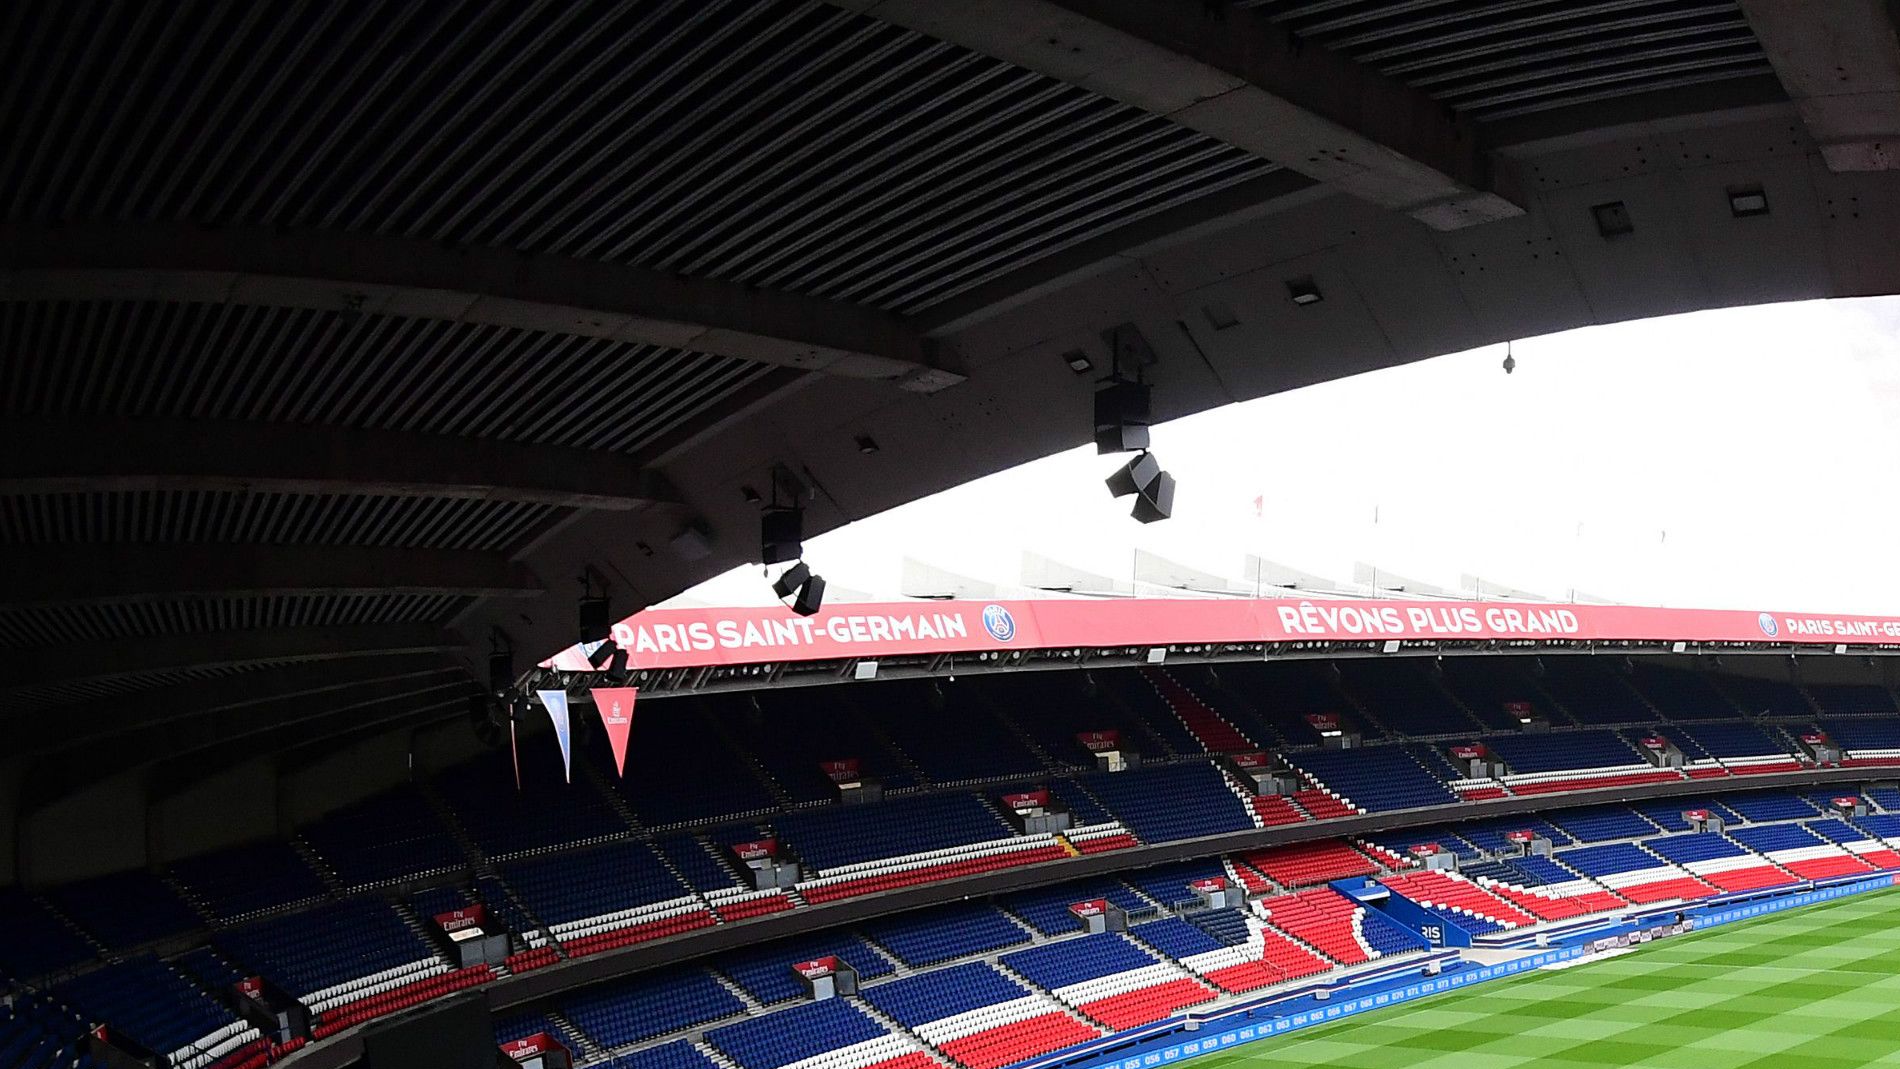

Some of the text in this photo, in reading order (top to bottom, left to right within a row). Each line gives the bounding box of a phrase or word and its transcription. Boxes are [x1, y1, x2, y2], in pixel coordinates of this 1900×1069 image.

[1277, 601, 1579, 634] RÊVONS PLUS GRAND
[612, 622, 715, 653] PARIS
[718, 613, 967, 648] SAINT-GERMAIN
[1786, 618, 1834, 636] PARIS
[1013, 799, 1038, 809] Emirates
[453, 911, 464, 919] Fly
[443, 917, 475, 932] Emirates
[1125, 1059, 1140, 1069] 055
[1145, 1054, 1160, 1064] 056
[1165, 1049, 1179, 1059] 057
[1184, 1044, 1199, 1054] 058
[1203, 1039, 1217, 1049] 059
[1222, 1034, 1236, 1044] 060
[1240, 1030, 1254, 1039] 061
